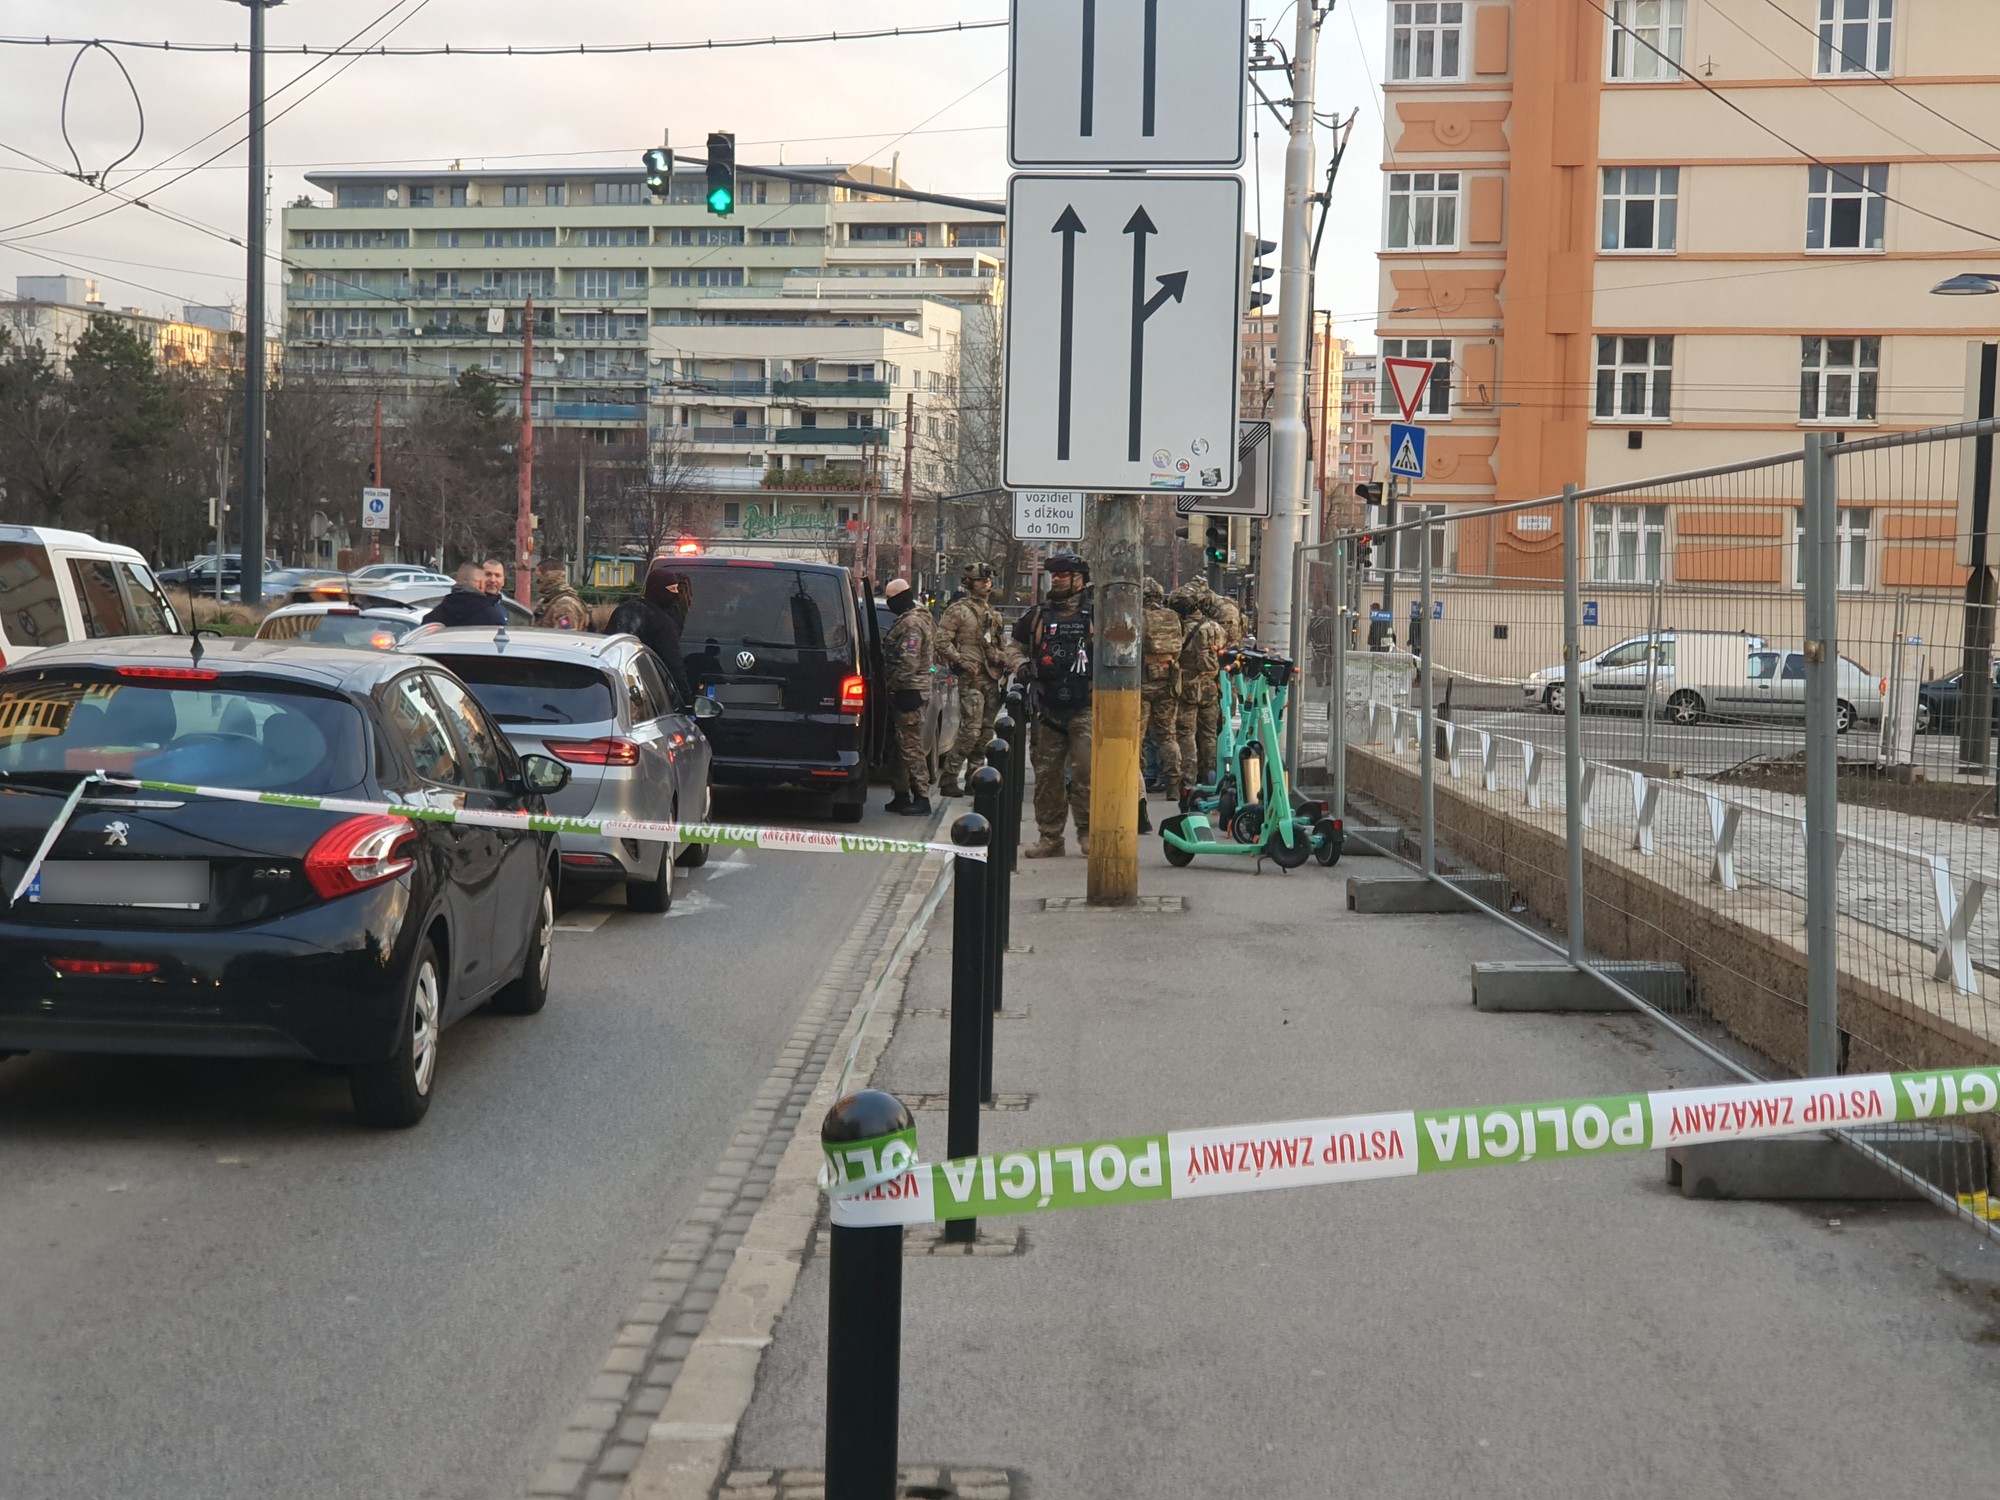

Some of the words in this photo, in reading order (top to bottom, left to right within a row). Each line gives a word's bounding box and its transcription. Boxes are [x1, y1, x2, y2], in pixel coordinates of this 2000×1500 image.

[1024, 509, 1030, 518] s
[1034, 504, 1074, 519] dĺžkou
[1027, 523, 1042, 533] do
[1046, 523, 1070, 534] 10m
[1668, 1095, 1794, 1142] ZAKÁZANÝ
[1803, 1088, 1883, 1124] VSTUP
[1322, 1128, 1405, 1165] VSTUP
[1424, 1100, 1645, 1162] POLÍCIA
[940, 1141, 1162, 1208] POLÍCIA
[1186, 1135, 1315, 1184] ZAKÁZANÝ
